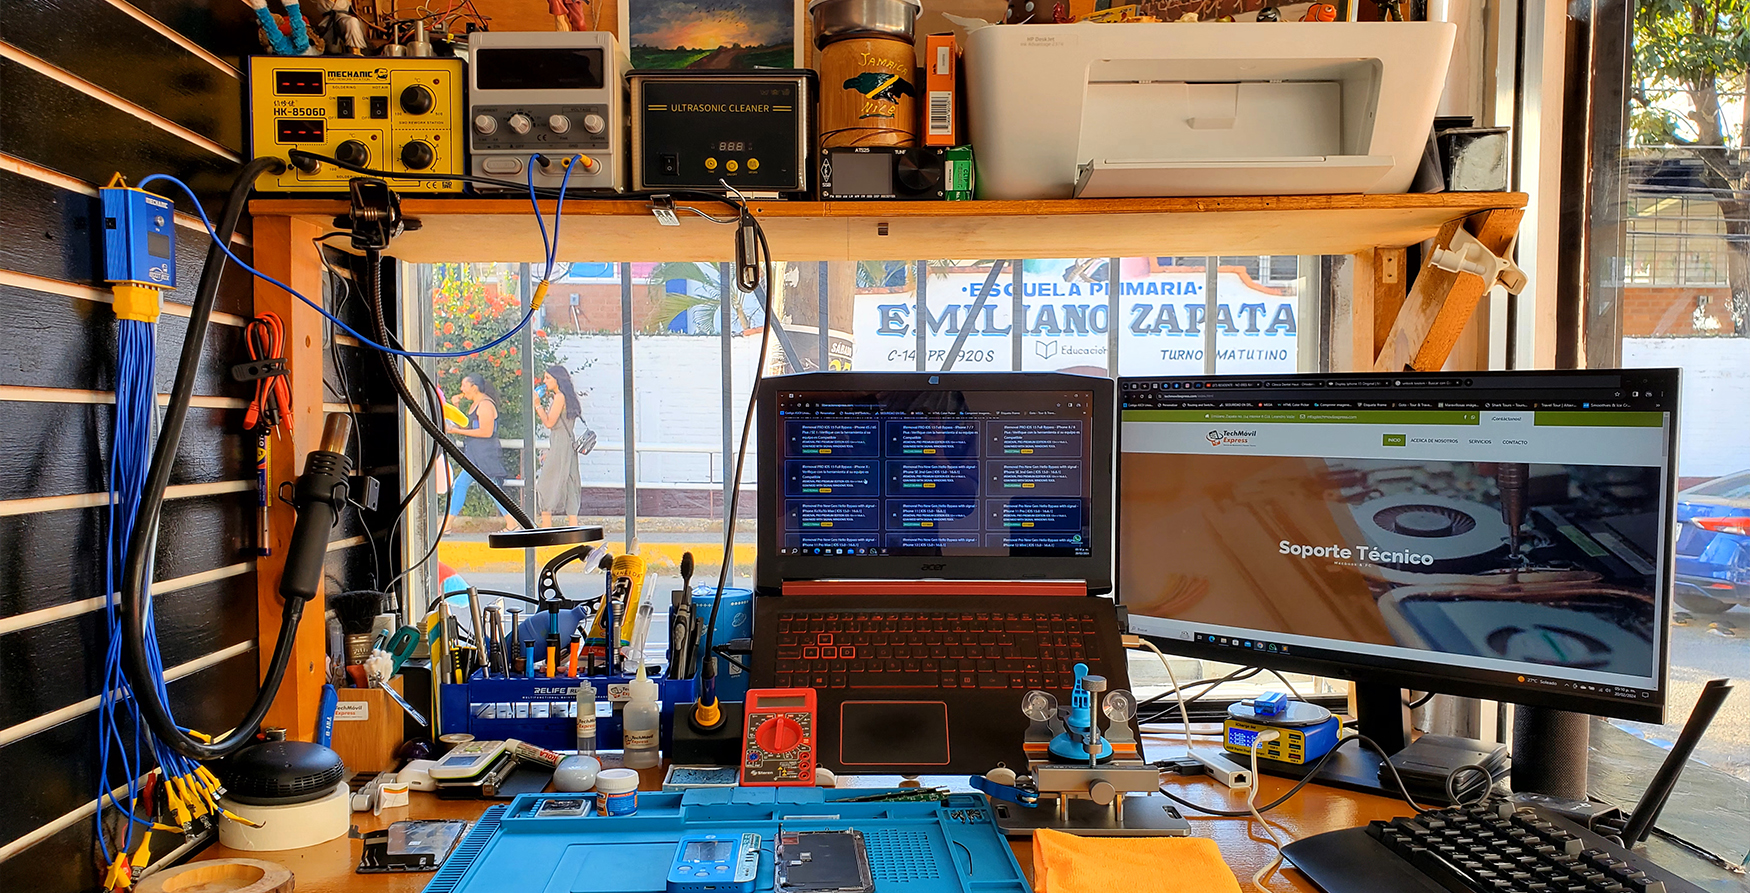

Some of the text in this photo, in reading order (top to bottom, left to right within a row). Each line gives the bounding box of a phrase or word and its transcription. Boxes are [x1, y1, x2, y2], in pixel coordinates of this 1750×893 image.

[857, 51, 909, 76] JAMAICA
[274, 108, 326, 116] HK-8506D
[671, 104, 770, 112] ULTRASONIC CLEANER
[970, 282, 1198, 298] ESCUELA PIMARIA
[1129, 302, 1296, 337] ZAPATA
[1162, 350, 1288, 360] TURNO MATUTINO
[1279, 540, 1434, 566] Soporte Técnico
